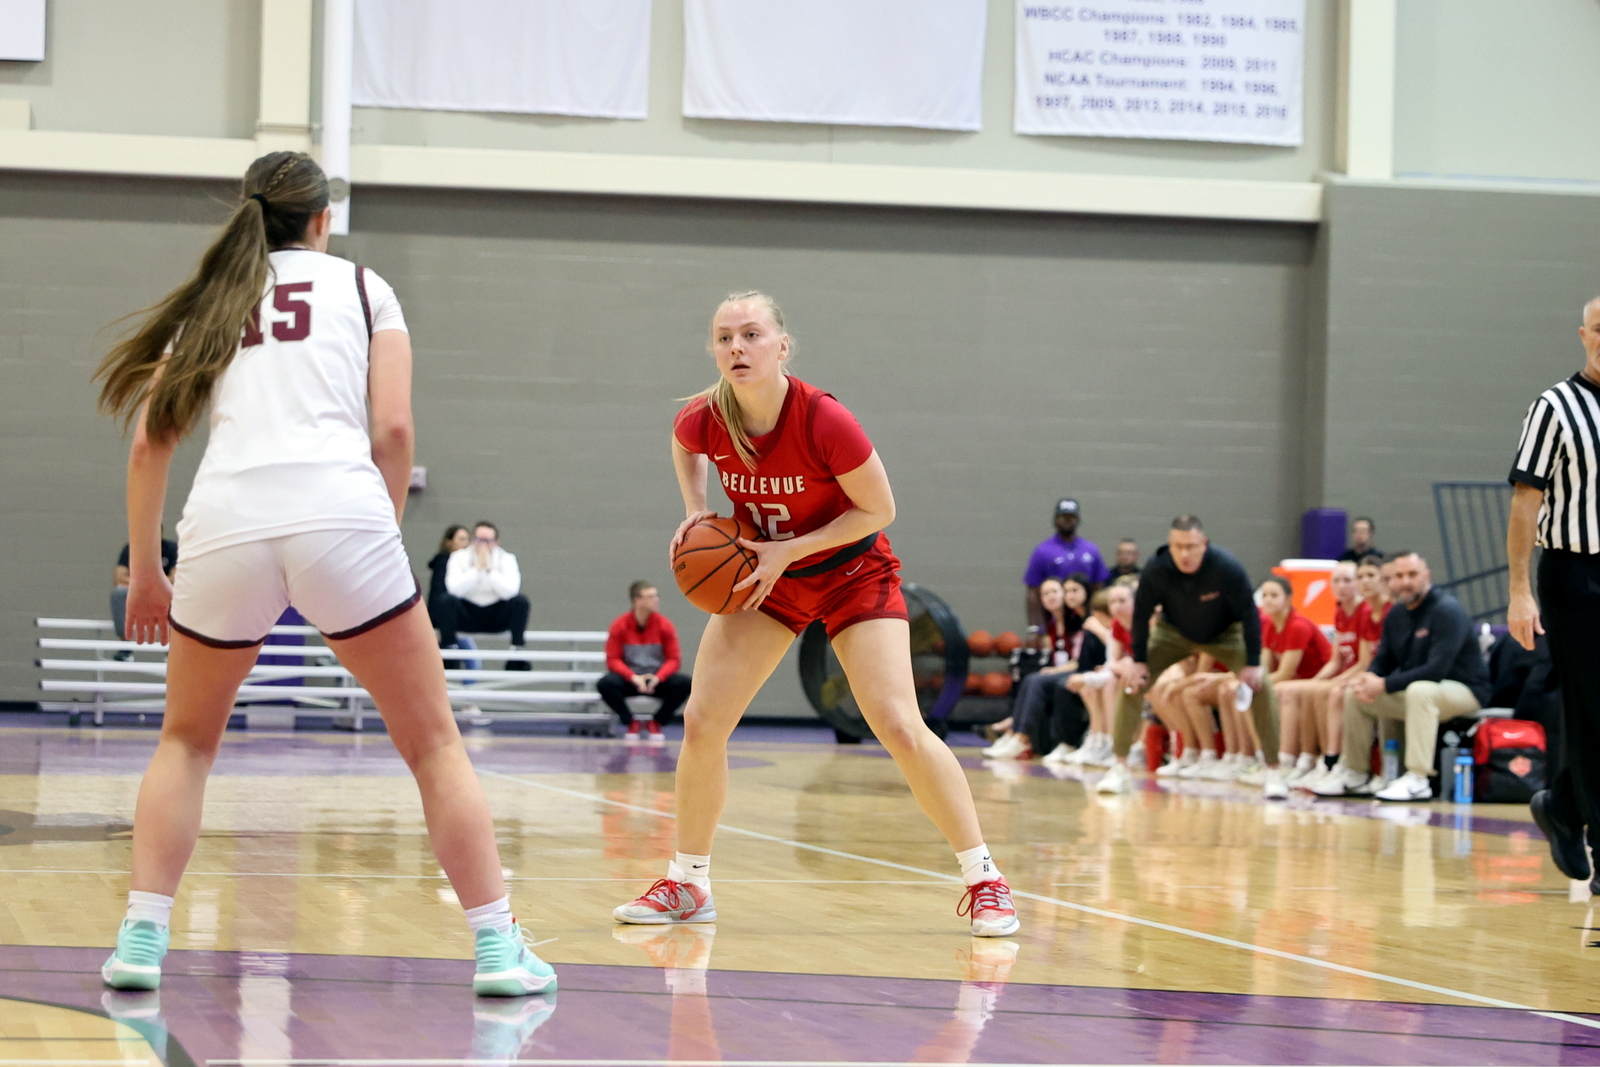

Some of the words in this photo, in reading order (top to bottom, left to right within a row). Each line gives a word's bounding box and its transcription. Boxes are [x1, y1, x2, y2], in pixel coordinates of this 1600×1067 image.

[1043, 72, 1090, 87] NCAA
[722, 471, 806, 495] BELLEVUE
[745, 501, 796, 540] 12
